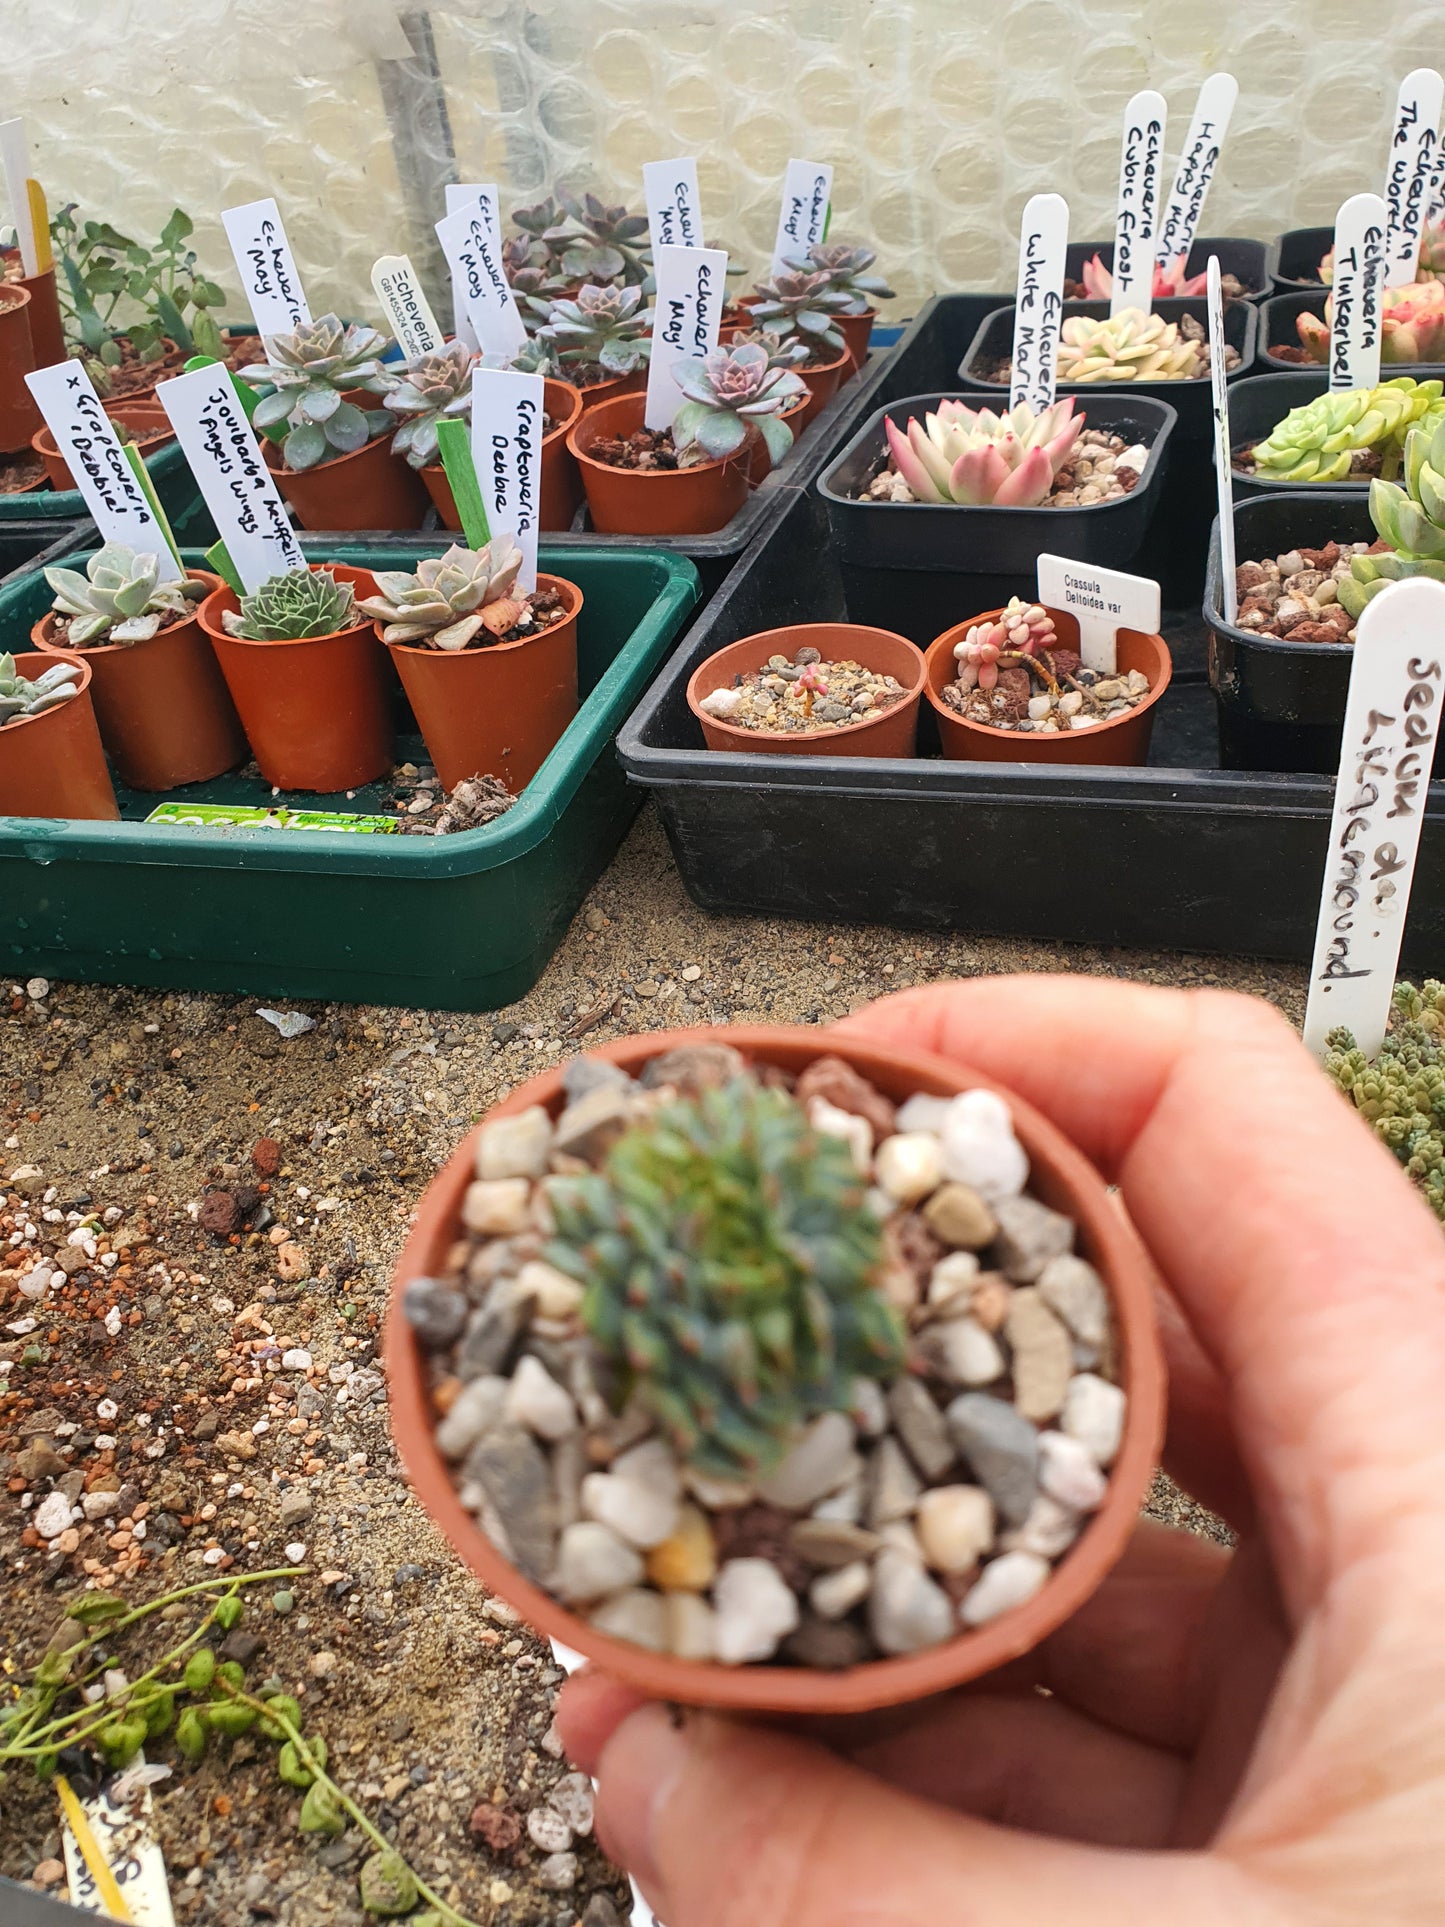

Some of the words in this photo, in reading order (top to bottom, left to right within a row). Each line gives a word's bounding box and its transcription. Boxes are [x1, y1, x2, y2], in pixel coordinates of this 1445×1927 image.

[1122, 126, 1143, 200] Cubic
[1176, 122, 1216, 195] Happy
[1393, 100, 1418, 148] The
[1140, 119, 1162, 240] Echeveria
[1397, 128, 1437, 260] Echeveria
[261, 219, 307, 328] Echeveria
[469, 219, 509, 309] Echeveria
[1117, 208, 1137, 293] Frost
[1361, 225, 1384, 350] Echeveria
[390, 269, 435, 353] Echeveria
[1331, 246, 1358, 388] Tinkerbell
[76, 394, 151, 524] Graptoveria
[208, 387, 266, 490] Jovibarba
[491, 434, 510, 514] Debbie
[513, 399, 537, 537] Graptoveria
[1064, 574, 1101, 594] Crassula
[1065, 590, 1105, 610] Deltoidea
[1107, 603, 1122, 614] var
